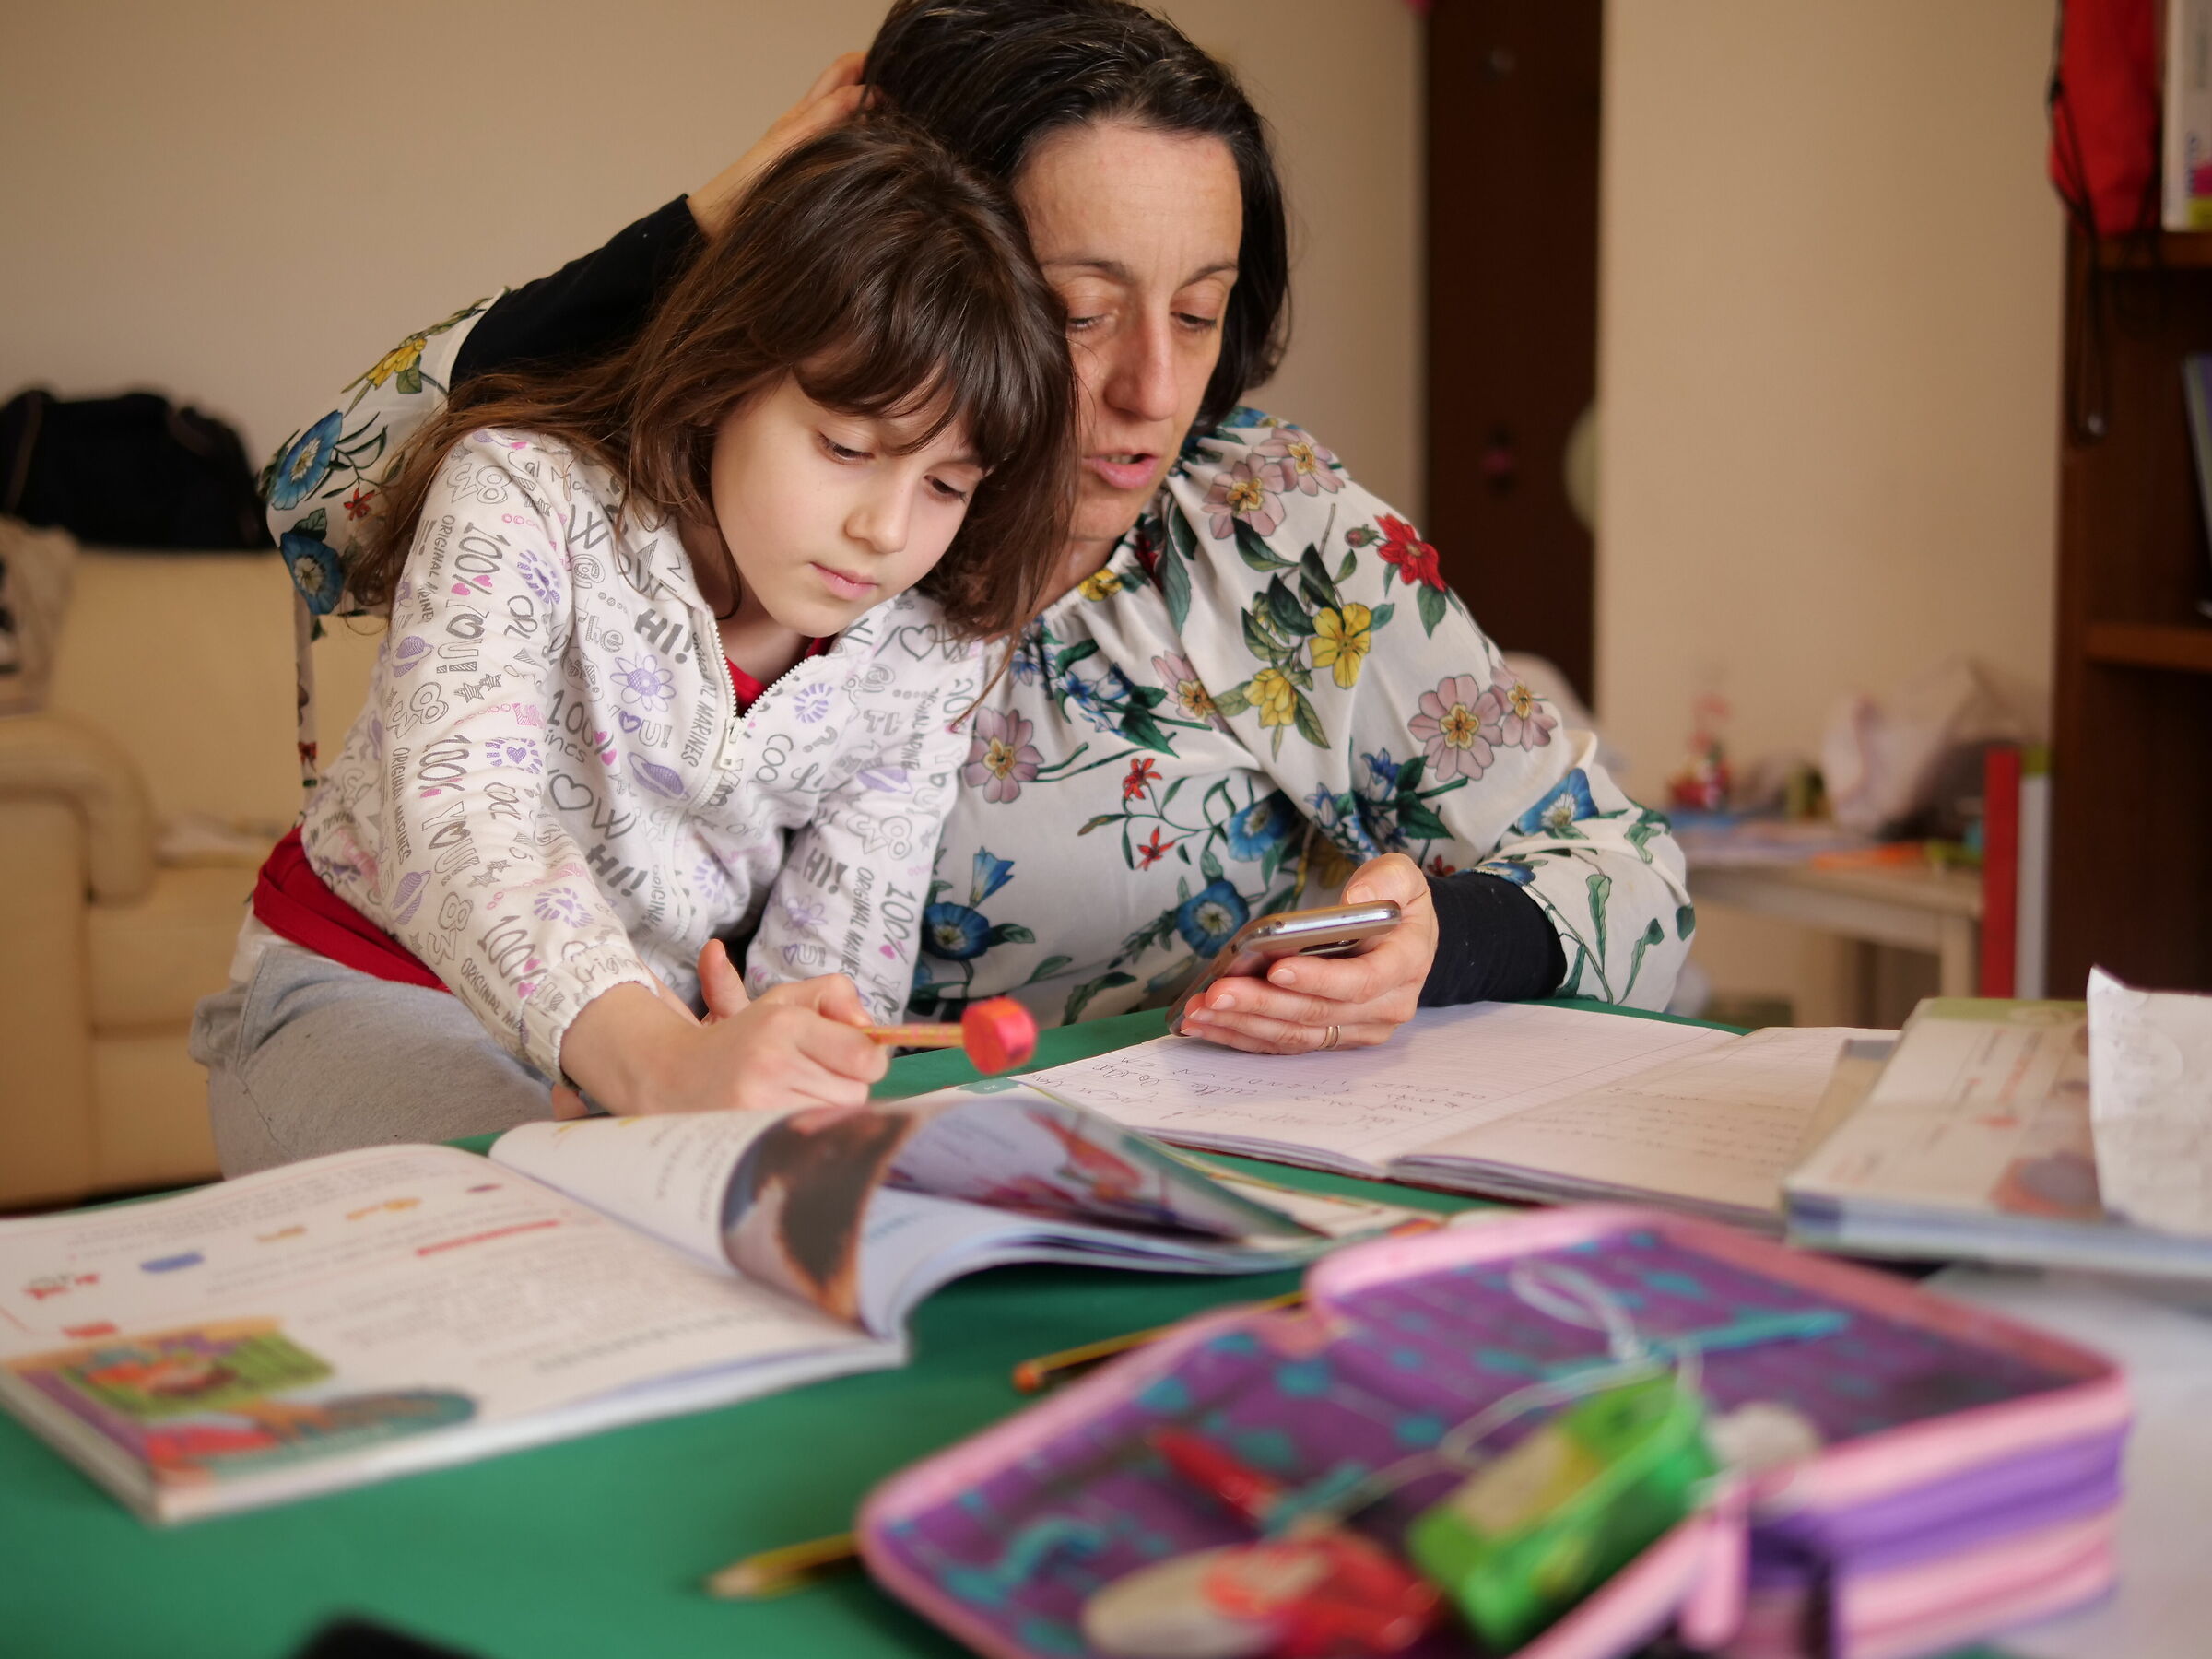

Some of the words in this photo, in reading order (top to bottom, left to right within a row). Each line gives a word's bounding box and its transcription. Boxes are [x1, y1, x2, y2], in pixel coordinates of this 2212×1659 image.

[429, 514, 455, 578] ORIGINAL
[634, 608, 690, 665] HI!
[680, 700, 715, 767] MARINES
[391, 747, 410, 805] ORIGINAL
[586, 843, 648, 897] HI!
[802, 847, 849, 894] HI!
[461, 957, 501, 1015] ORIGINAL
